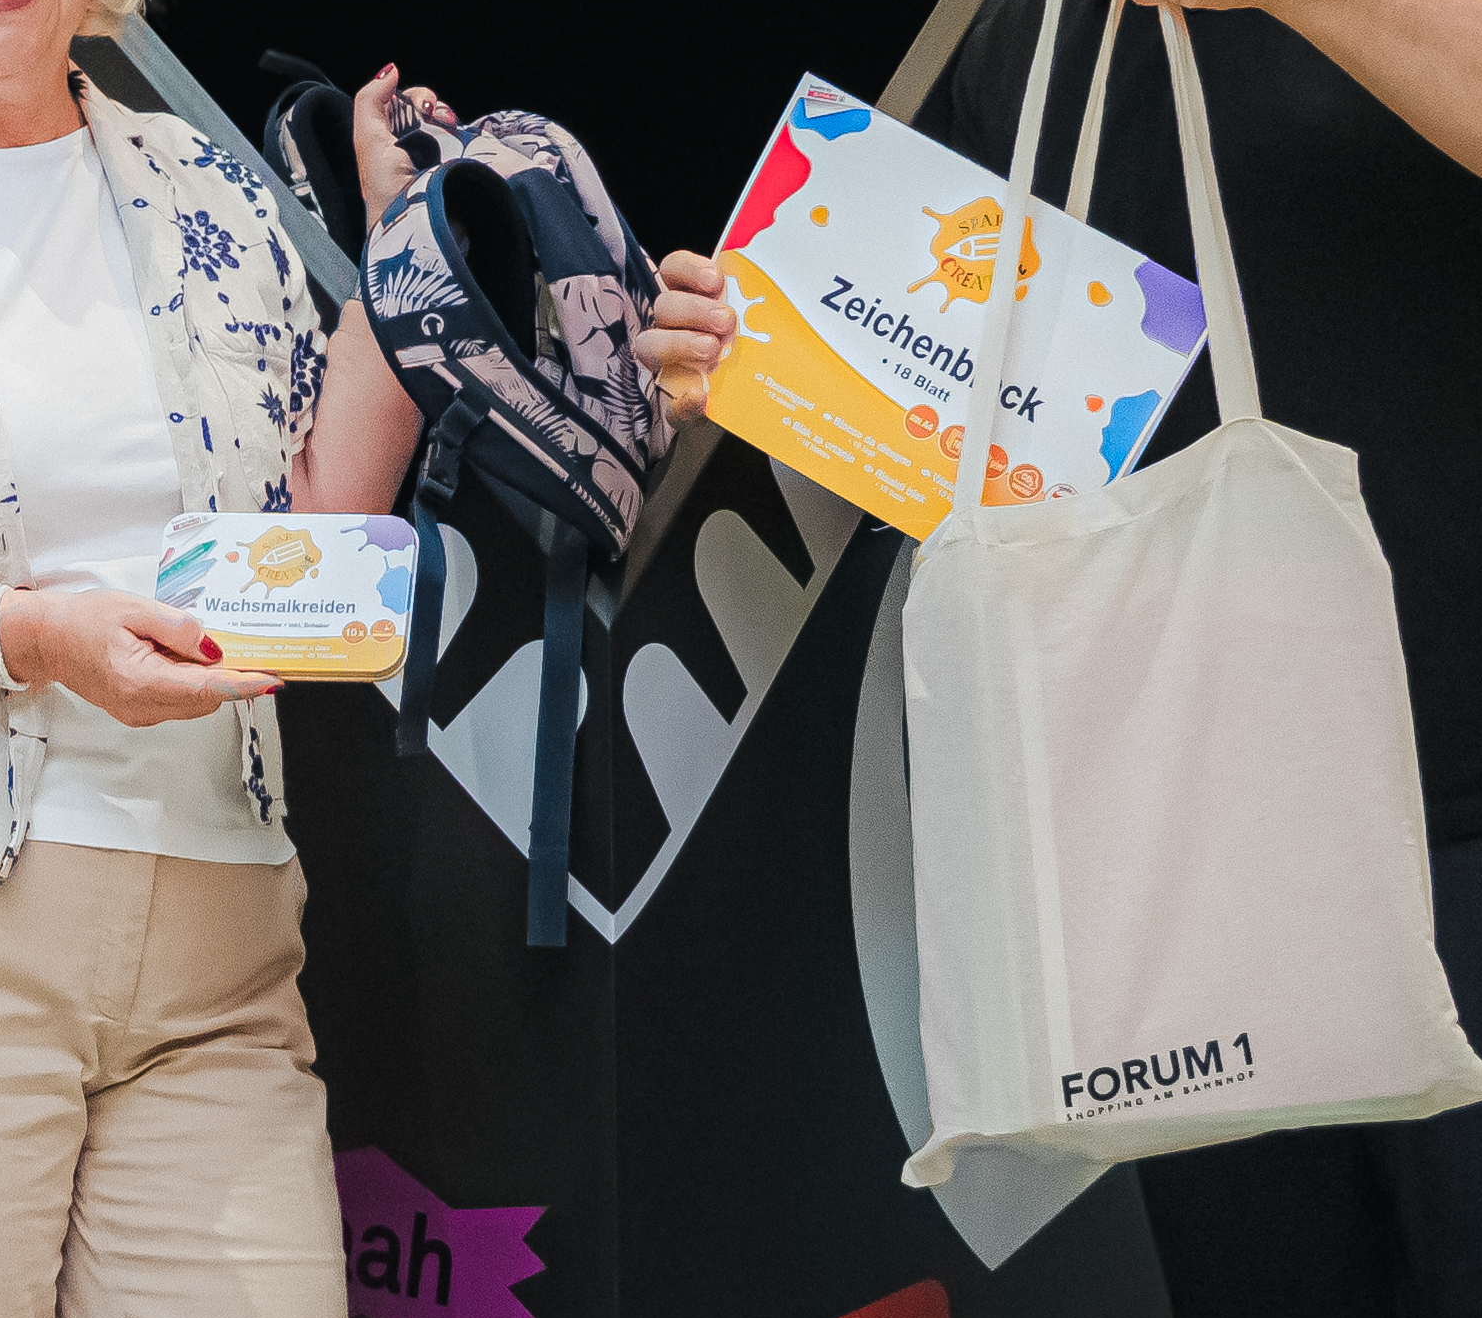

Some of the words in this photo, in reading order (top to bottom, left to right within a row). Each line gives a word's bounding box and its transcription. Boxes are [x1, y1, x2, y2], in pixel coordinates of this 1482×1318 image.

[820, 275, 1045, 423] Zeichenbck
[894, 363, 912, 380] 18
[914, 375, 952, 403] Blatt
[204, 597, 356, 614] Wachsmalkreiden
[1061, 1040, 1224, 1108] FORUM
[1232, 1032, 1254, 1066] 1
[1066, 1097, 1144, 1122] SHOPPING
[1153, 1090, 1174, 1102] AM
[1183, 1070, 1256, 1095] BAHNHOF
